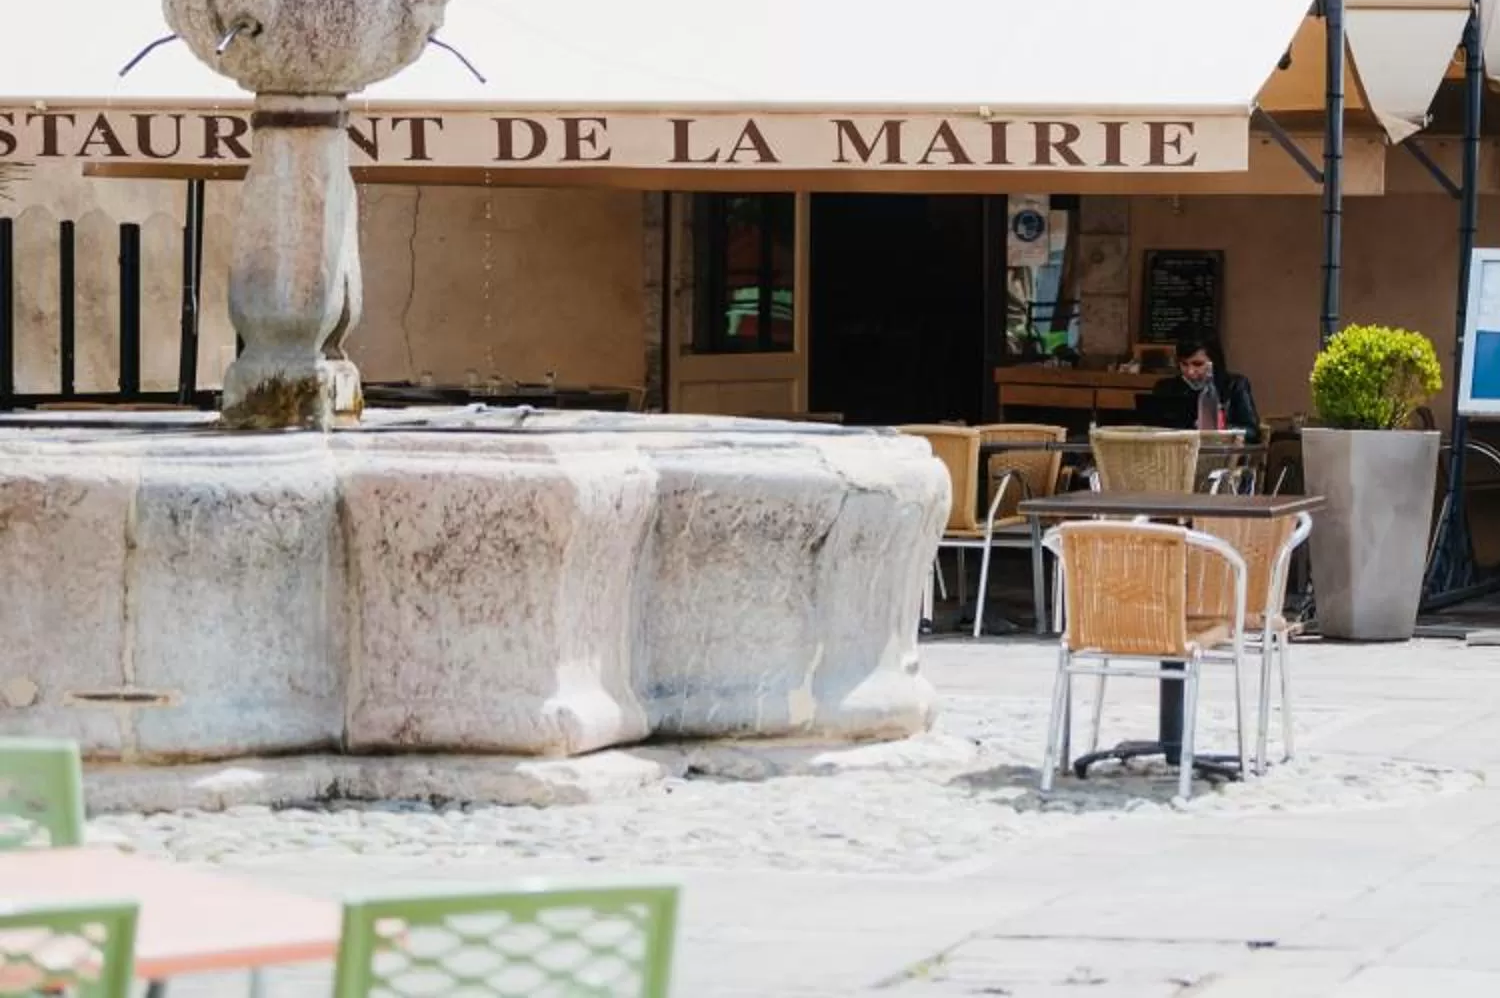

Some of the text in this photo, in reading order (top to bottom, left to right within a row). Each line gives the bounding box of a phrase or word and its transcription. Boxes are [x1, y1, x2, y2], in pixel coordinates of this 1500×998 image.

[0, 112, 1197, 167] STAURNT DE LA MAIRIE
